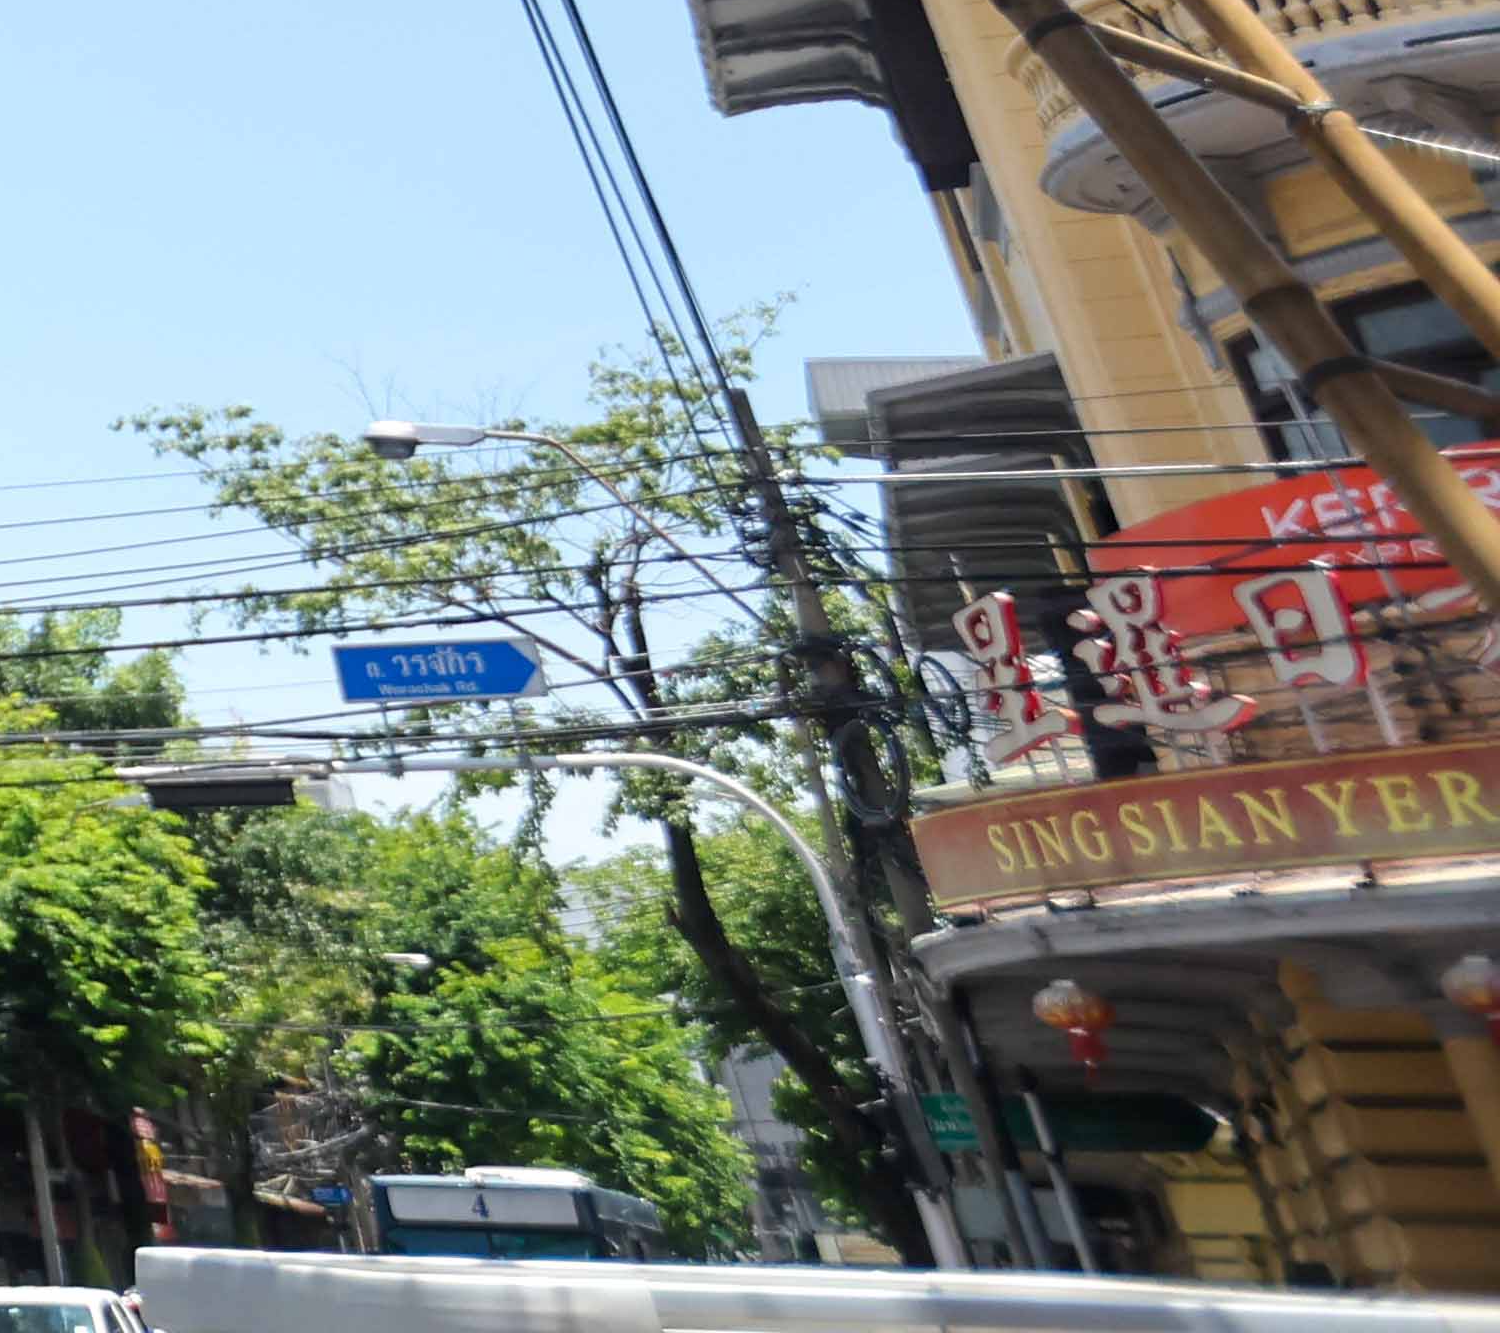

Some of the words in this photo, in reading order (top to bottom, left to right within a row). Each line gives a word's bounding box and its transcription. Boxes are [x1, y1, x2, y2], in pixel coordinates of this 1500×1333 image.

[391, 645, 486, 677] วรจักร
[987, 809, 1112, 874] SING
[1118, 788, 1301, 858] SIAN
[1303, 769, 1500, 839] YER
[470, 1192, 490, 1219] 4
